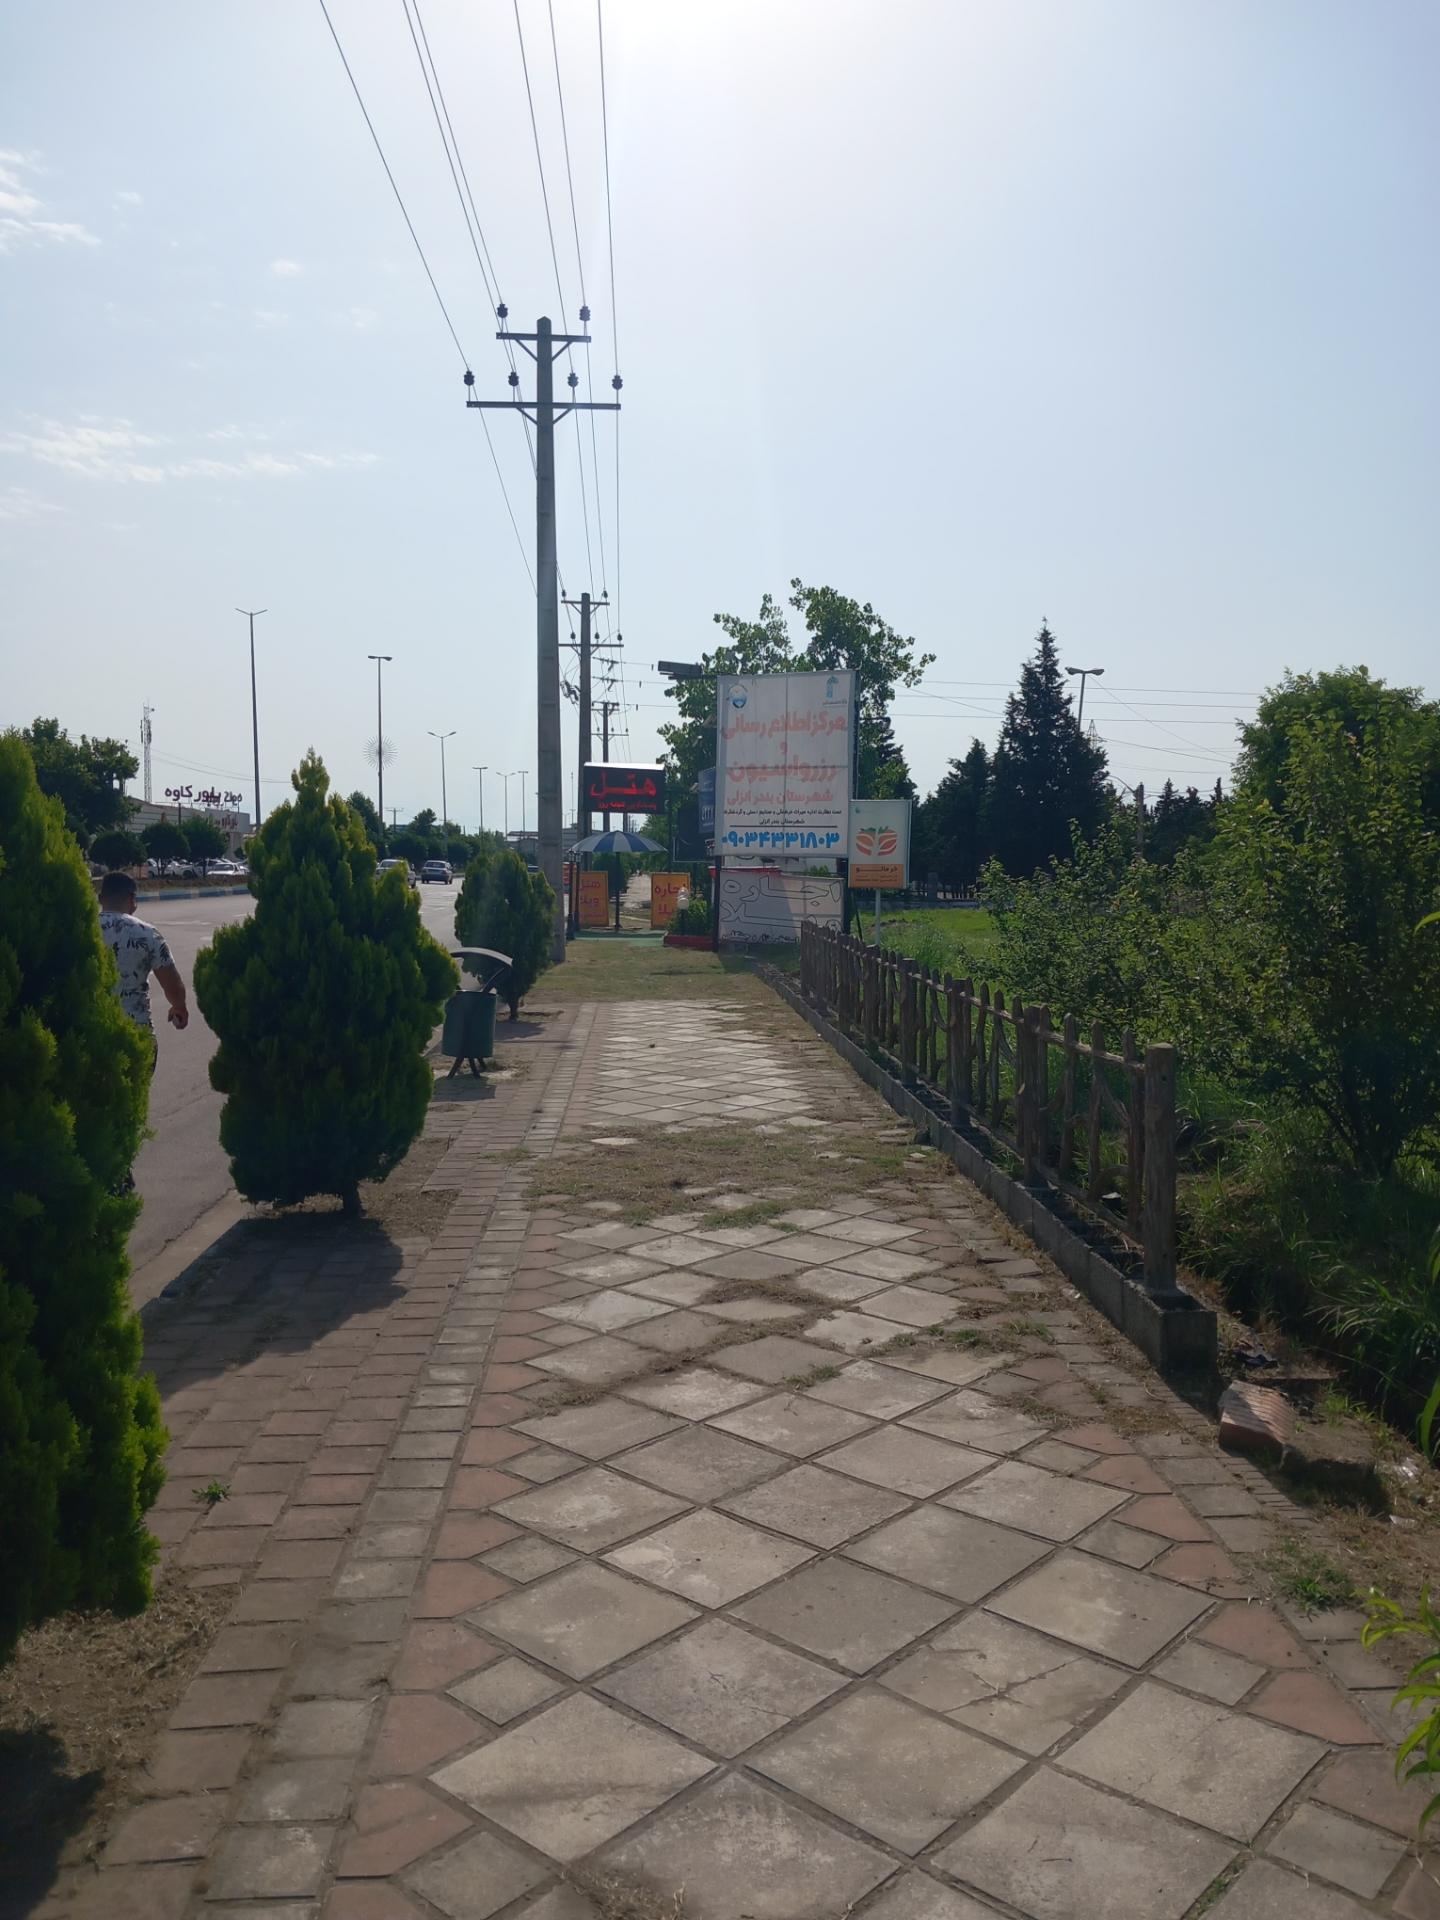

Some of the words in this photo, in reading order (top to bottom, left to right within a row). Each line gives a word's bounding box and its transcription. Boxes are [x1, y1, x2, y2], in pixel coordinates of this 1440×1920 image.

[722, 713, 767, 740] رسانی
[768, 710, 811, 737] اطلاع
[810, 711, 846, 736] مرکز
[779, 742, 788, 755] و
[726, 755, 838, 784] رزرواسیون
[165, 785, 193, 801] کاوه
[589, 771, 657, 799] هتل
[727, 790, 752, 805] انزلی
[753, 792, 774, 805] بندر
[776, 789, 834, 805] شهرستان
